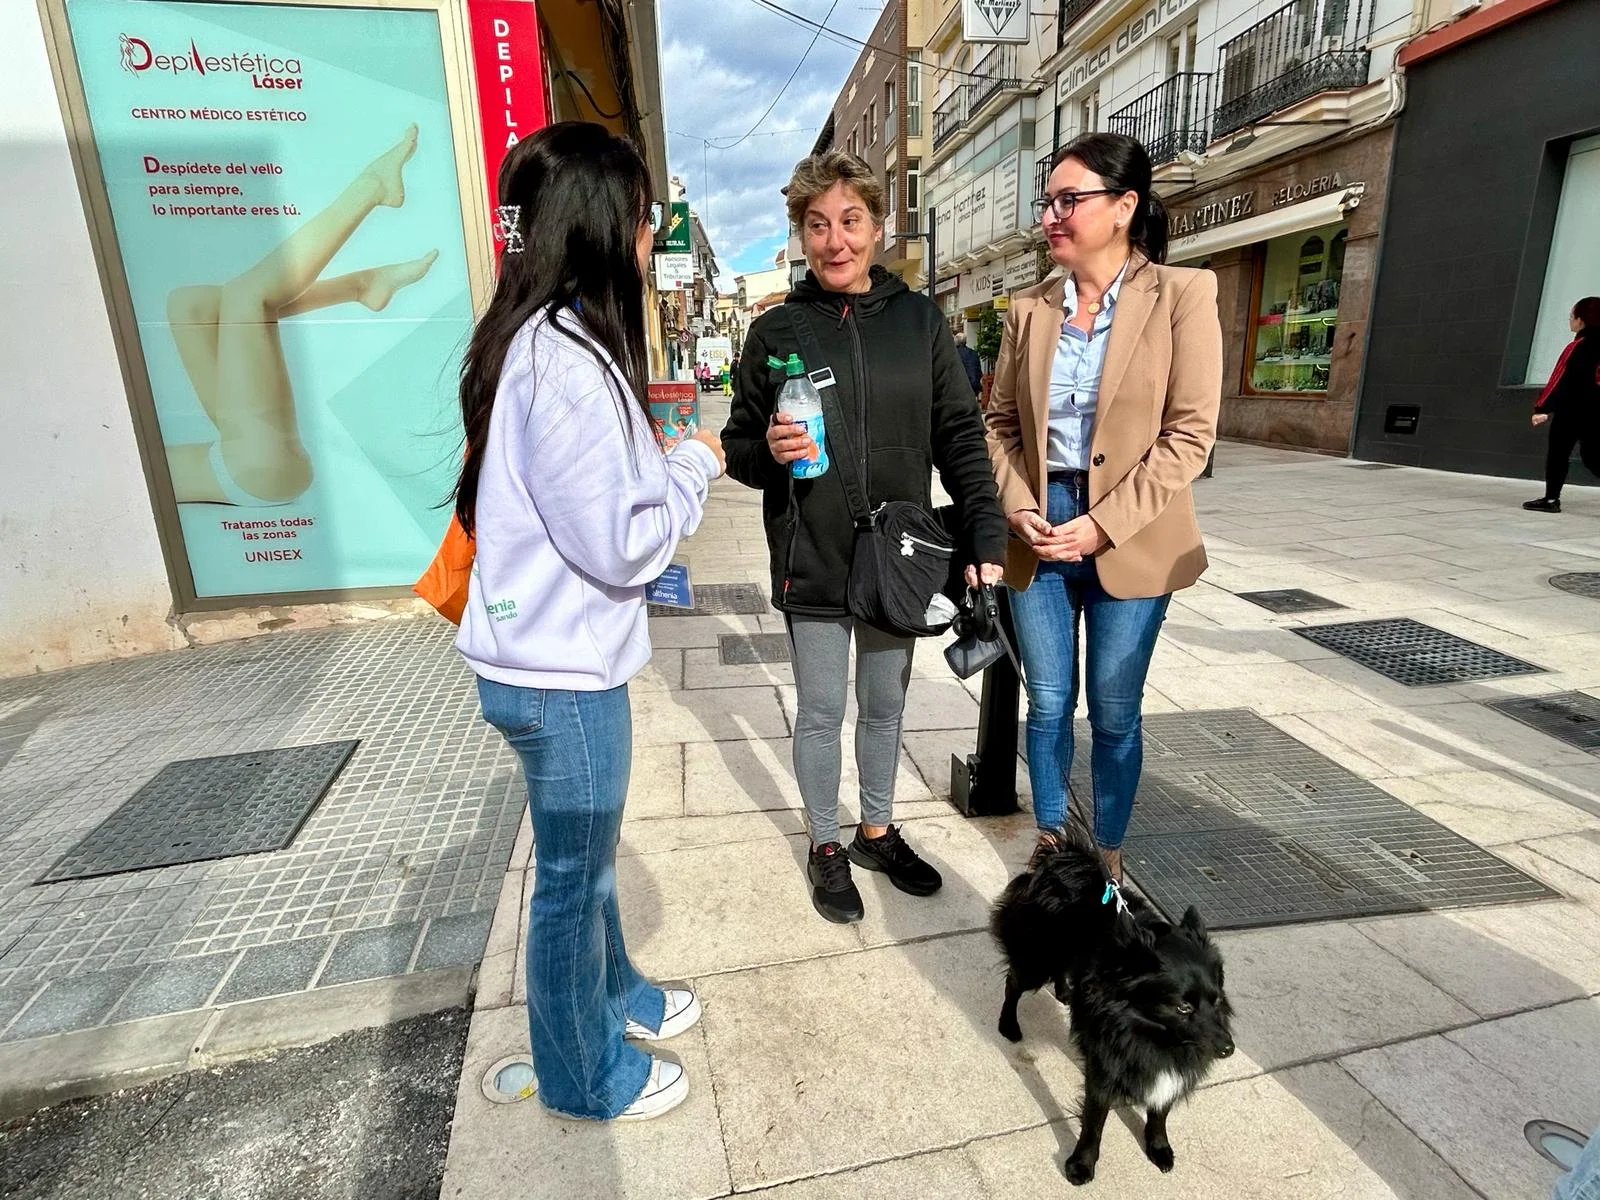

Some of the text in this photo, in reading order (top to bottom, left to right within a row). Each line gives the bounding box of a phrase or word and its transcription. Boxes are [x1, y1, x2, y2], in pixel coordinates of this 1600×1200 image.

[1116, 0, 1189, 54] denta
[119, 32, 301, 79] Depilestética
[252, 74, 302, 89] Láser
[131, 106, 307, 122] CENTRO MÉDICO ESTÉTICO
[143, 156, 283, 176] Despídete del vello
[149, 182, 243, 197] para siempre,
[1271, 172, 1341, 206] RELOJERIA
[152, 203, 302, 218] lo importante eres tú.
[221, 517, 313, 530] Tratamos todas
[243, 530, 297, 540] las zonas
[245, 549, 303, 562] UNISEX
[496, 611, 517, 622] sando
